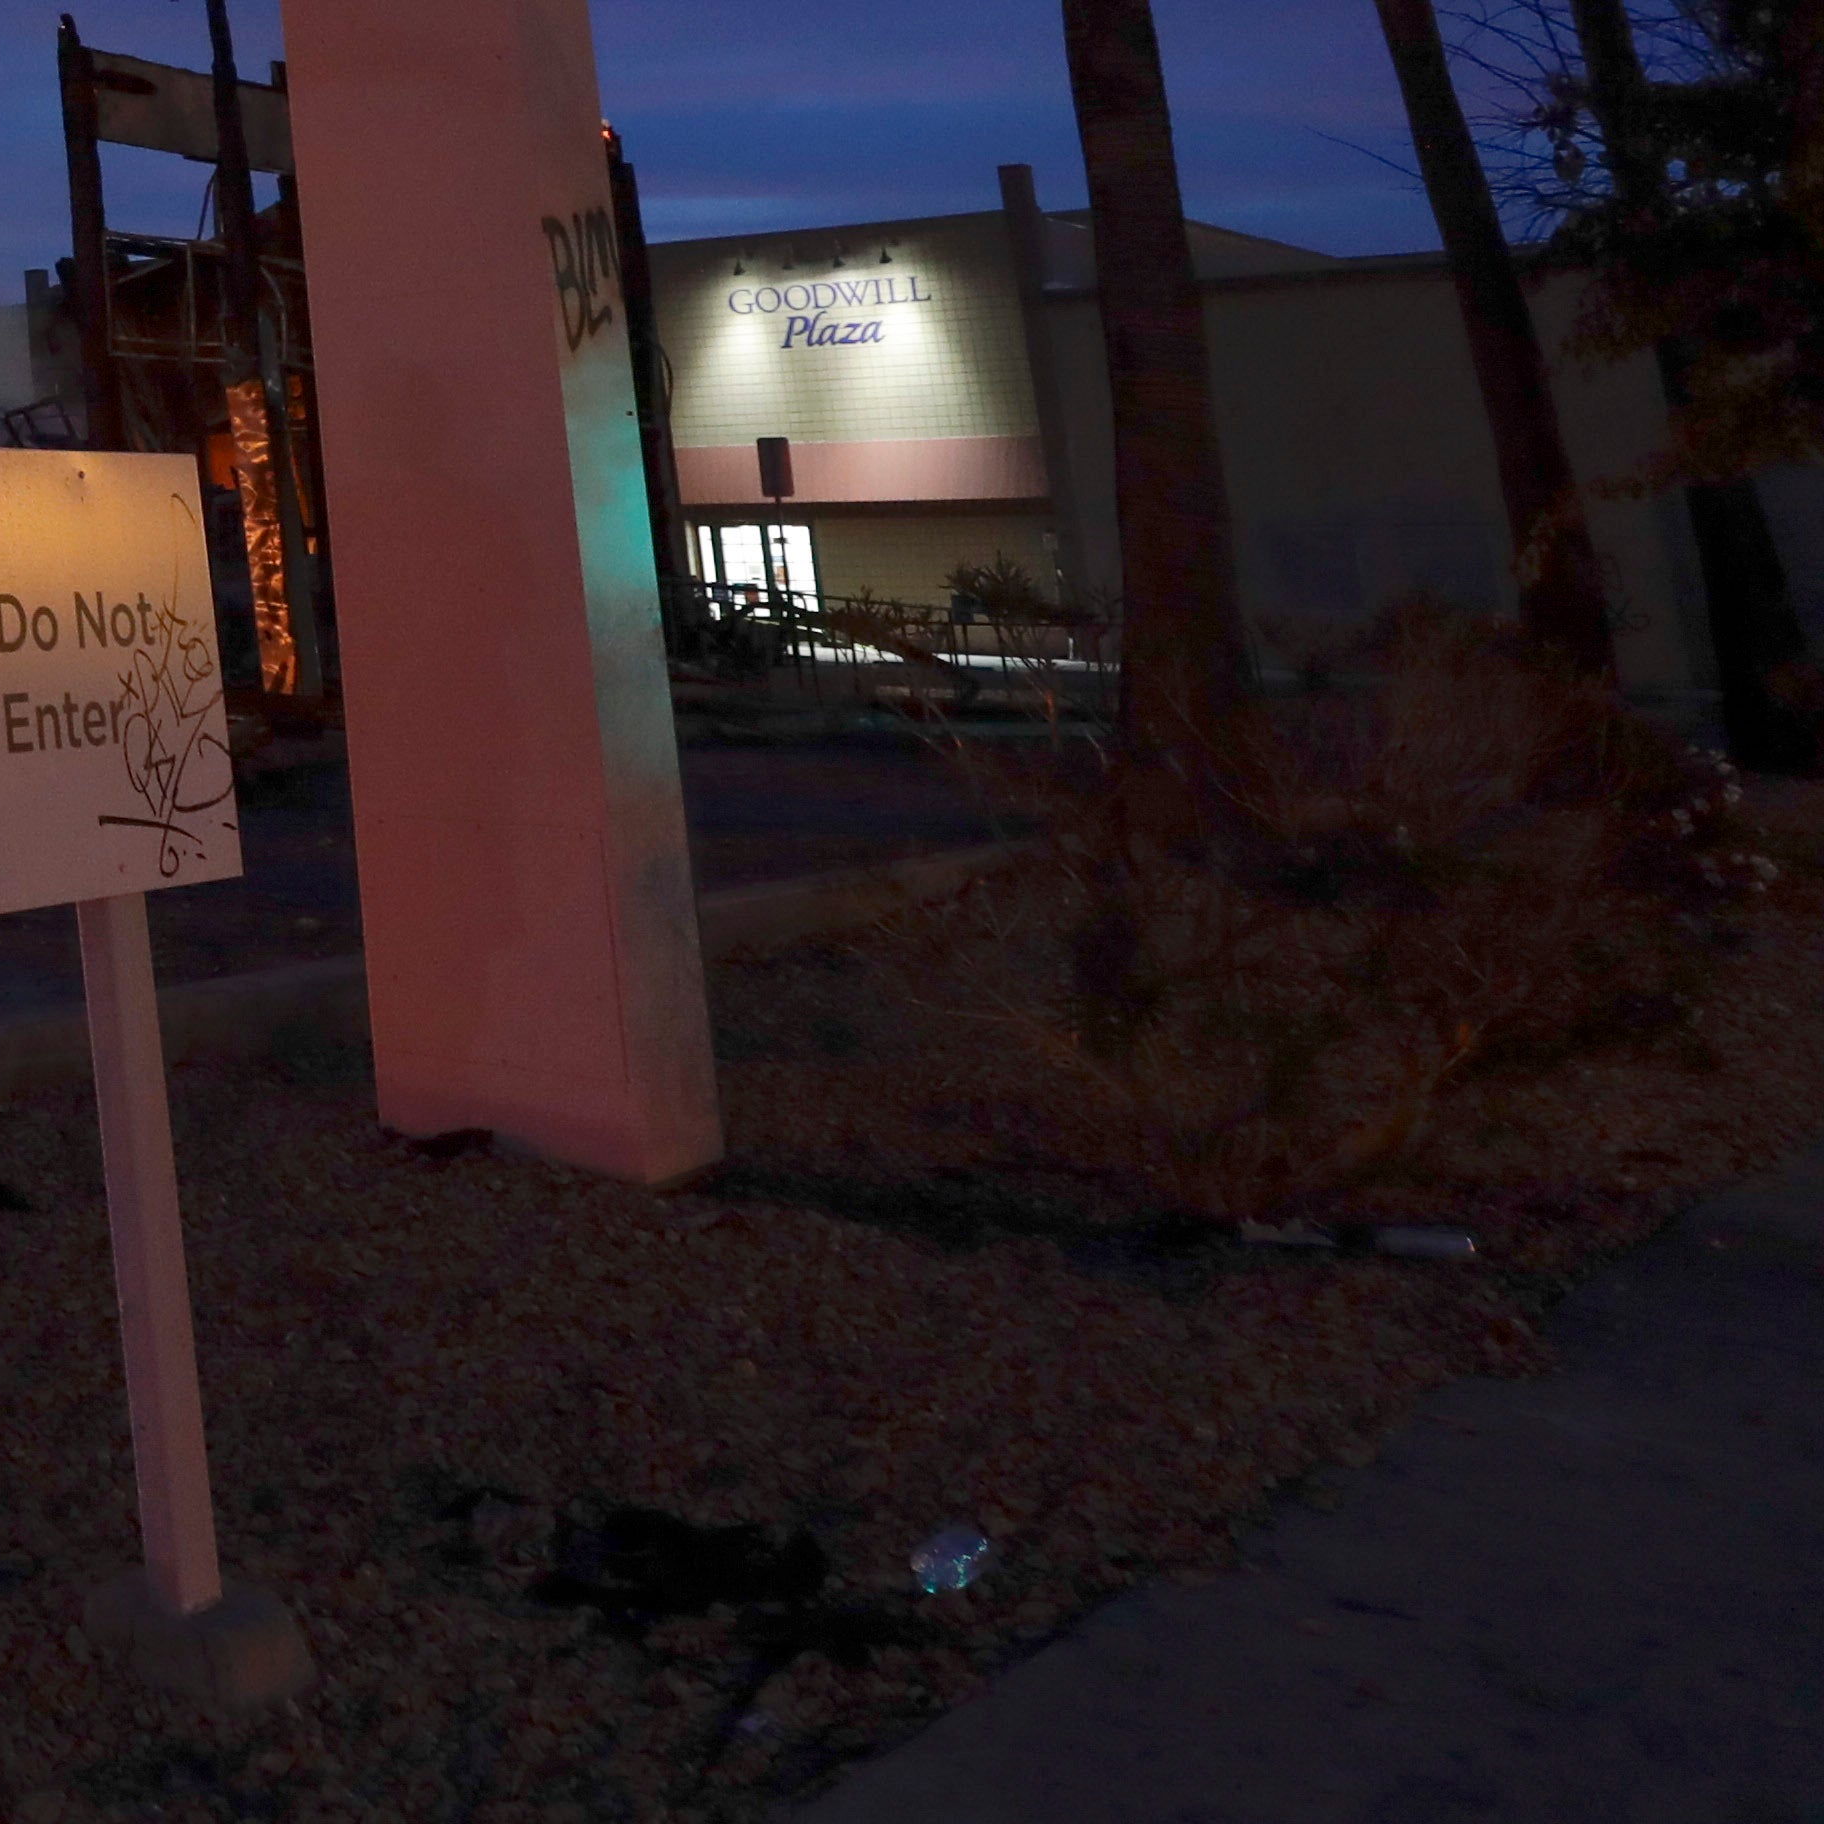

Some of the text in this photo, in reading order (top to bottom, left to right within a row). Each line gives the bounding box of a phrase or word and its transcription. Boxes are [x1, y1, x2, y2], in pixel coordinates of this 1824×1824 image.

[728, 276, 932, 315] GOODWILL
[781, 310, 886, 349] Plaza
[73, 591, 155, 650] Not
[2, 692, 127, 754] Enter
